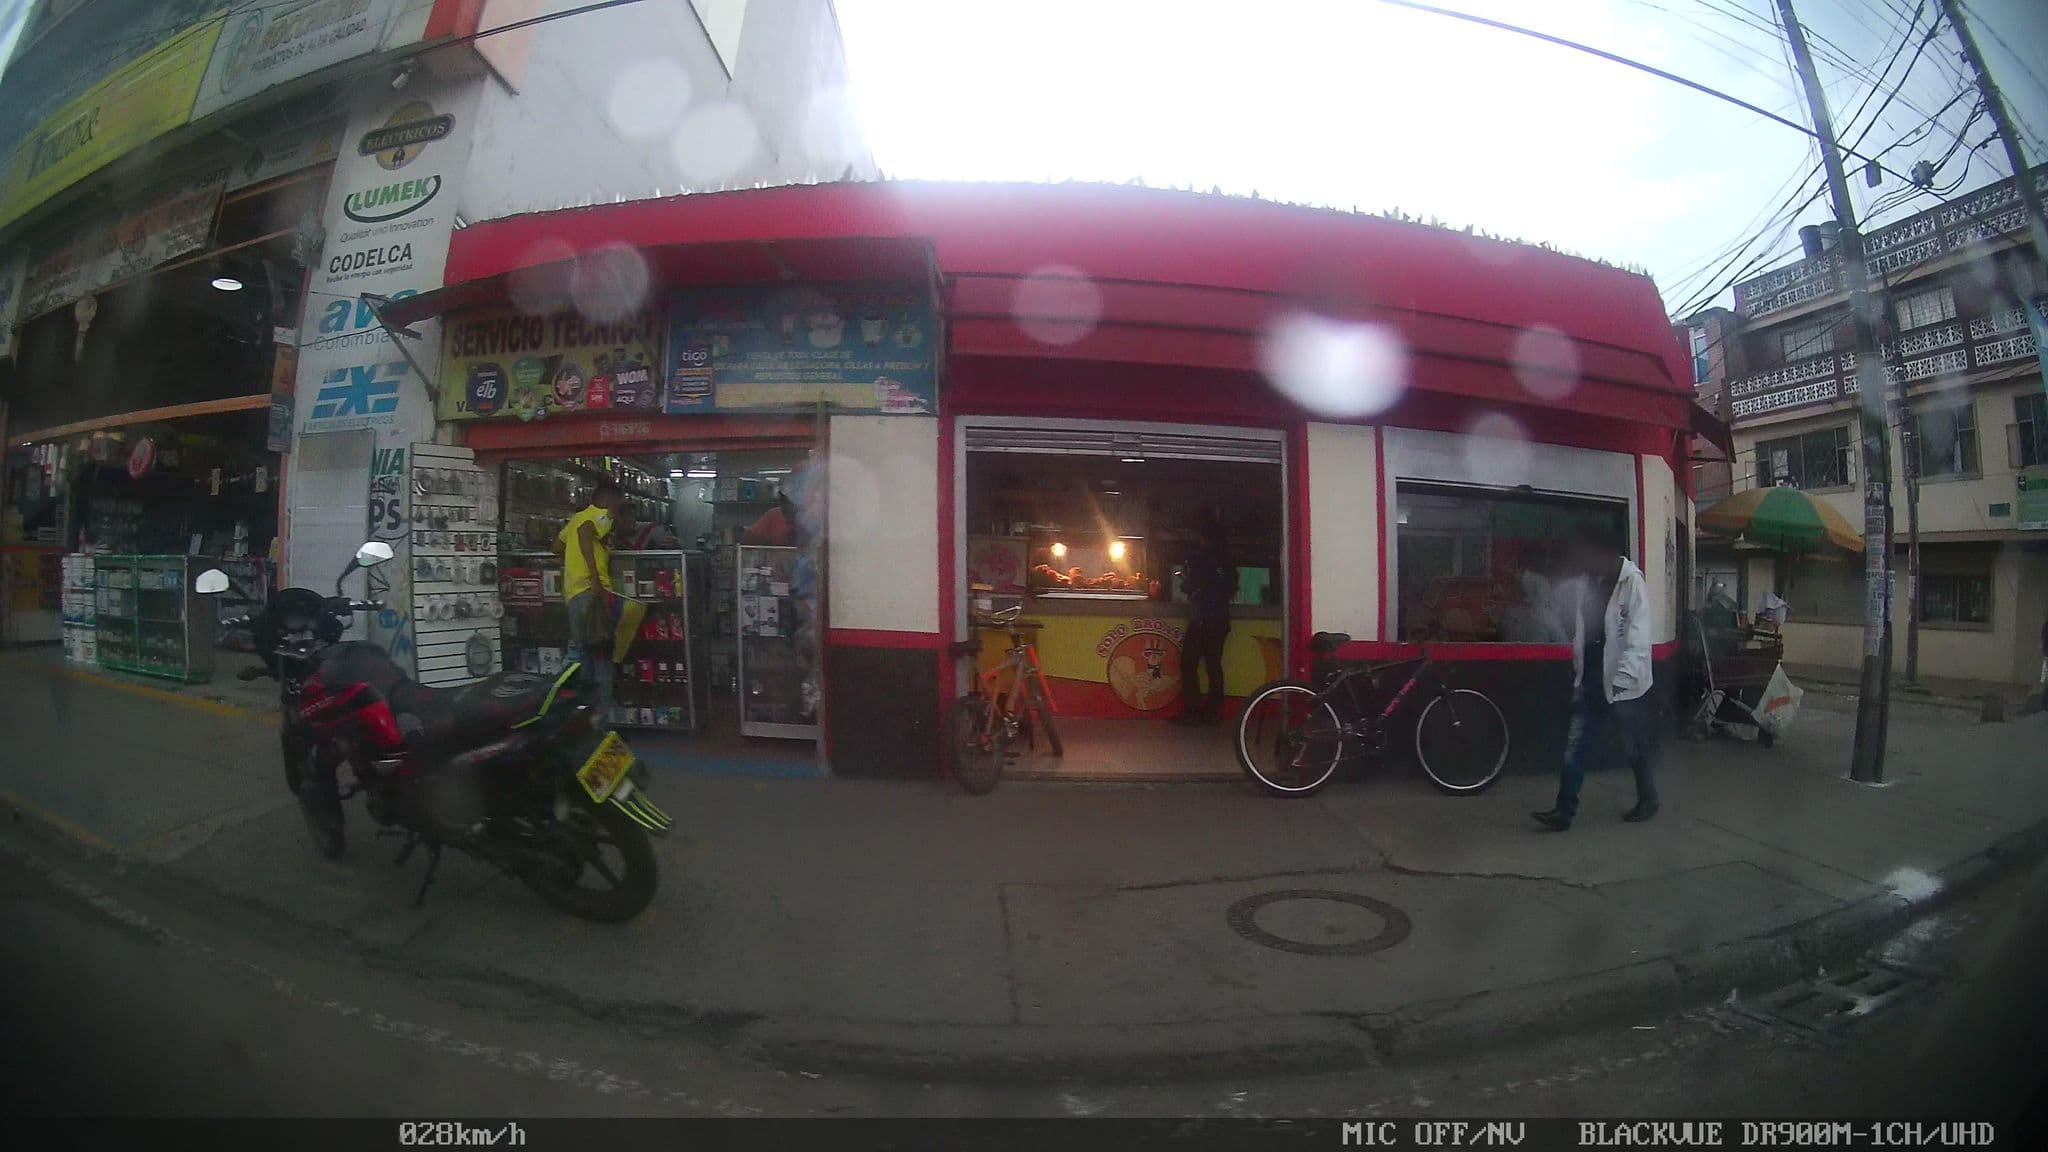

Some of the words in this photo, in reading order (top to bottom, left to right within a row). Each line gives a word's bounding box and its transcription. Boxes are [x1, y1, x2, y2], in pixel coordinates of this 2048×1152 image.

[350, 176, 434, 212] LUMEK
[329, 243, 412, 274] CODELCA
[453, 314, 544, 357] SERVICIO
[682, 350, 707, 366] tigo
[615, 369, 649, 385] WOM
